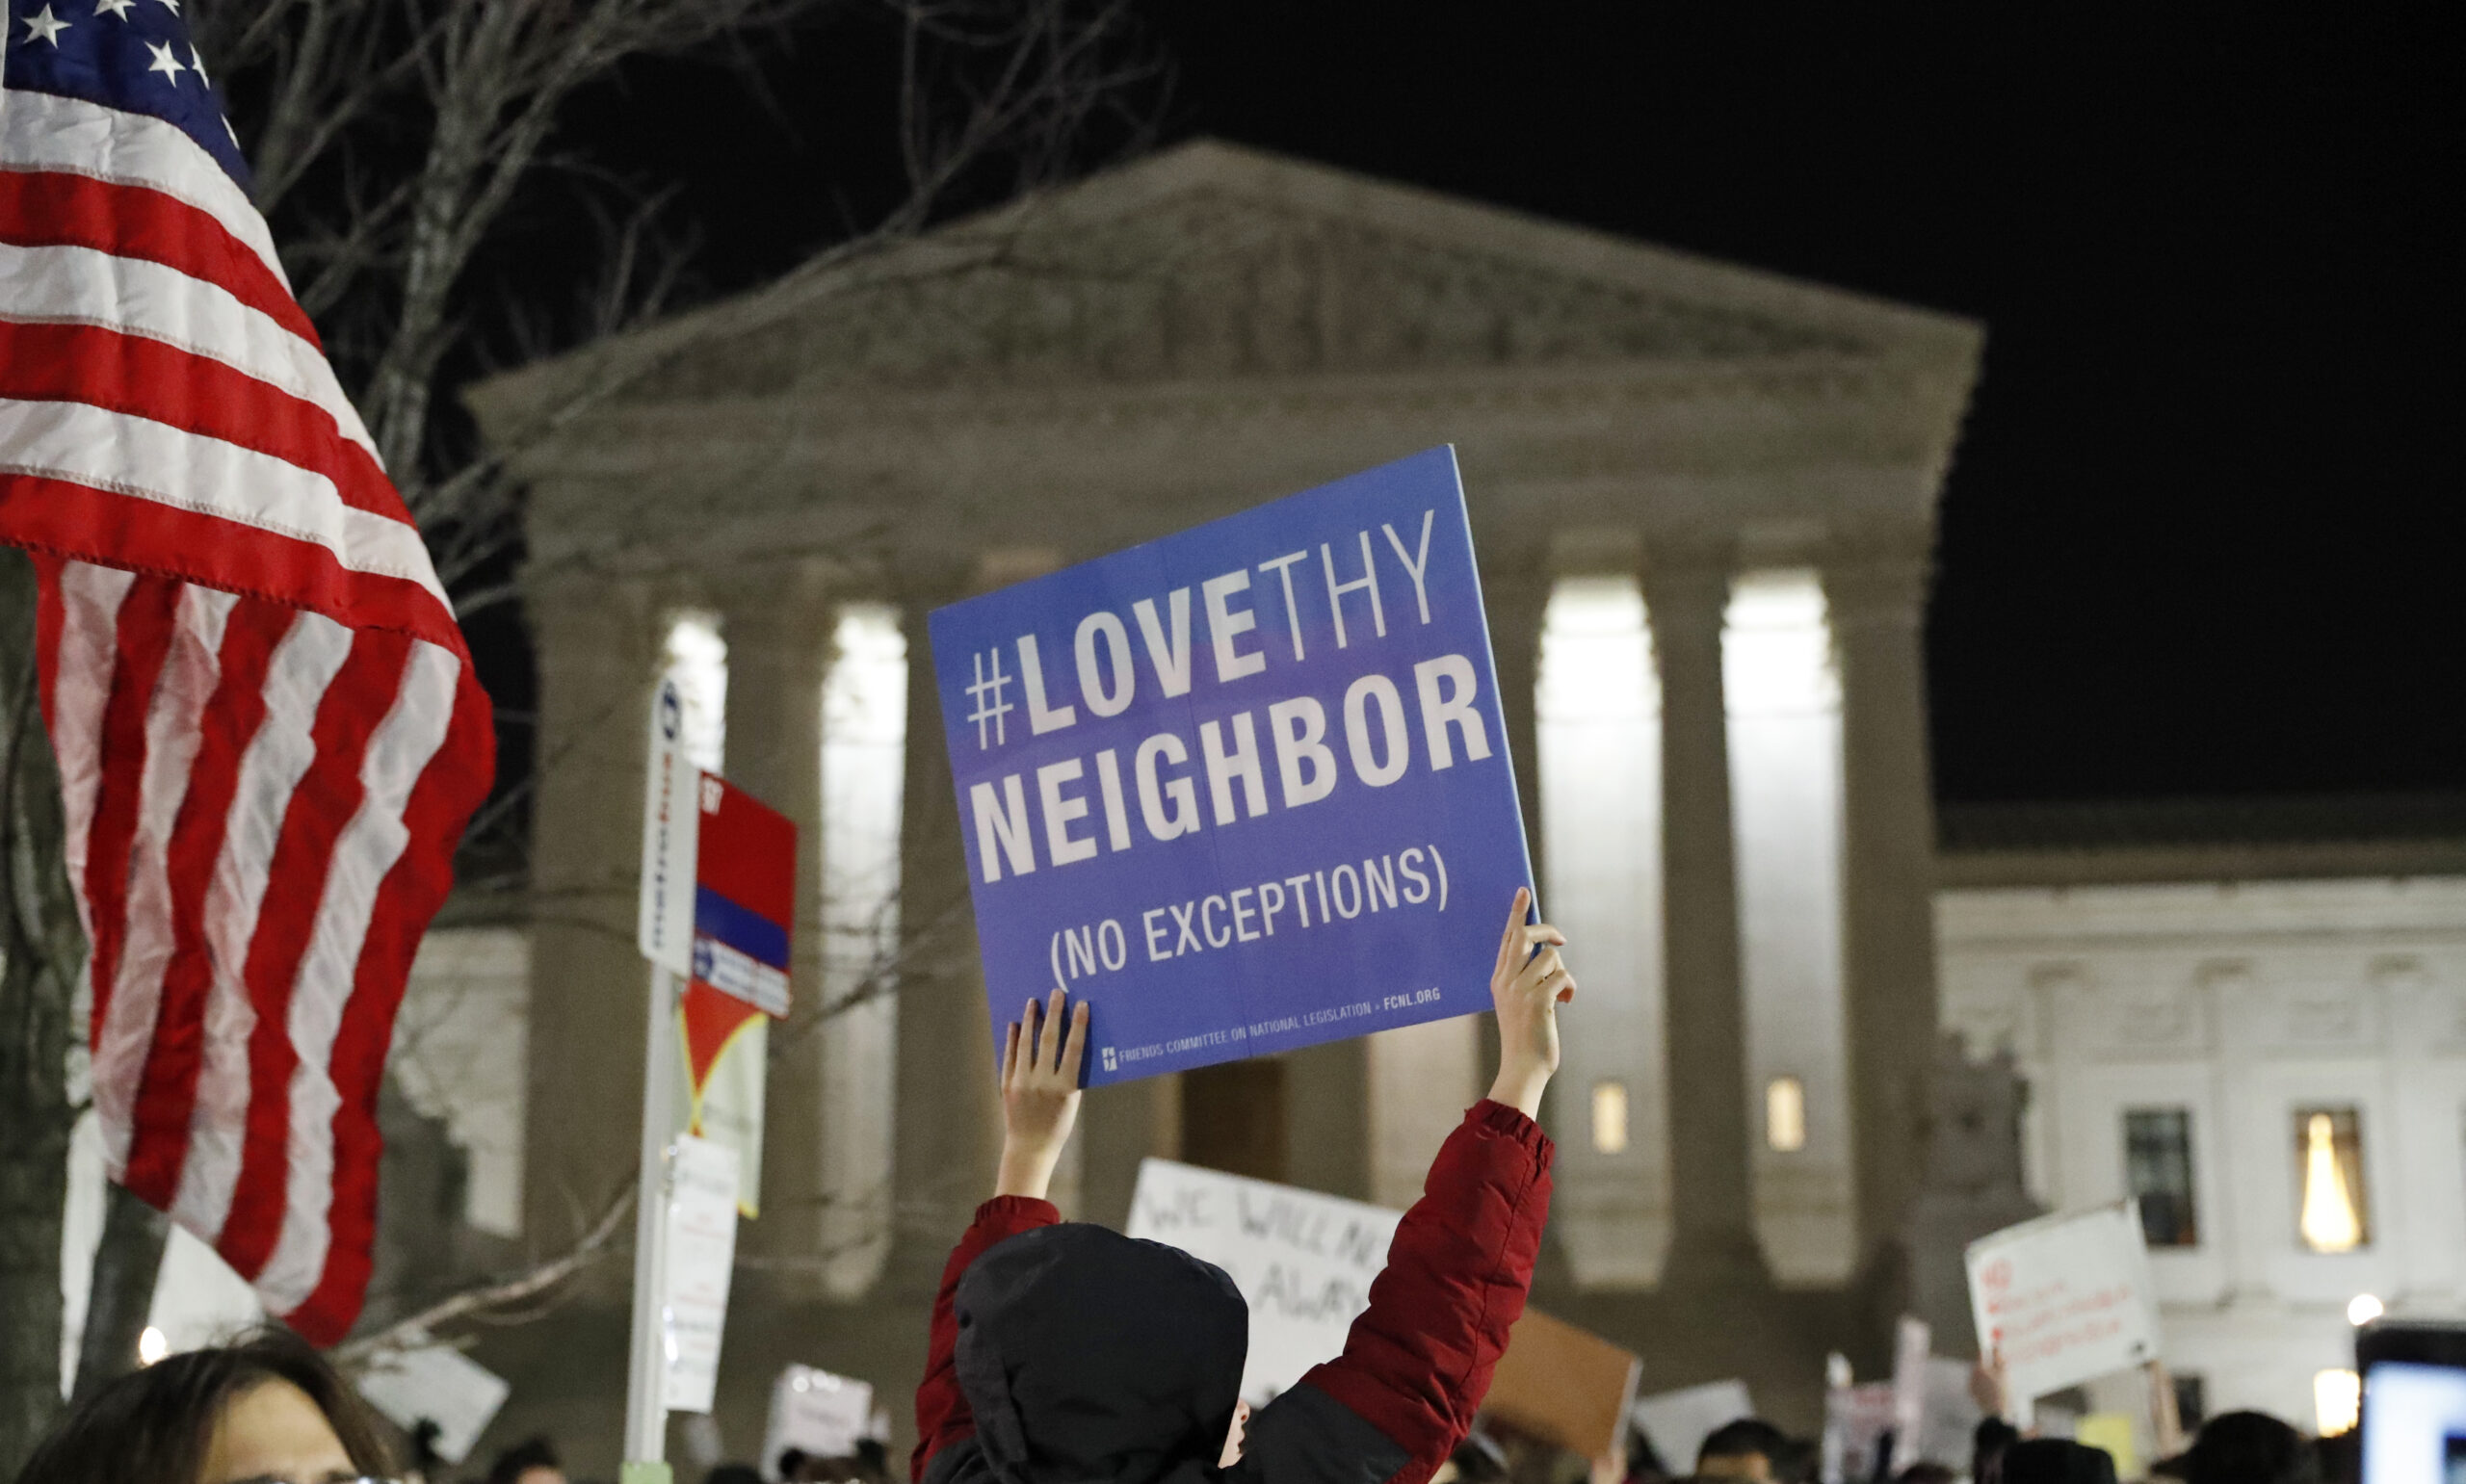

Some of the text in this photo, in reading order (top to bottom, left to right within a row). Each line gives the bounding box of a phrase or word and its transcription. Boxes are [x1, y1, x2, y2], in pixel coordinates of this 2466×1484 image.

[969, 654, 1493, 884] NEIGHBOR
[1051, 844, 1449, 994] (NO EXCEPTIONS)
[1118, 986, 1441, 1063] FRIENDS COMMITTEE ON NATIONAL LEGISLATION FCNL.ORG
